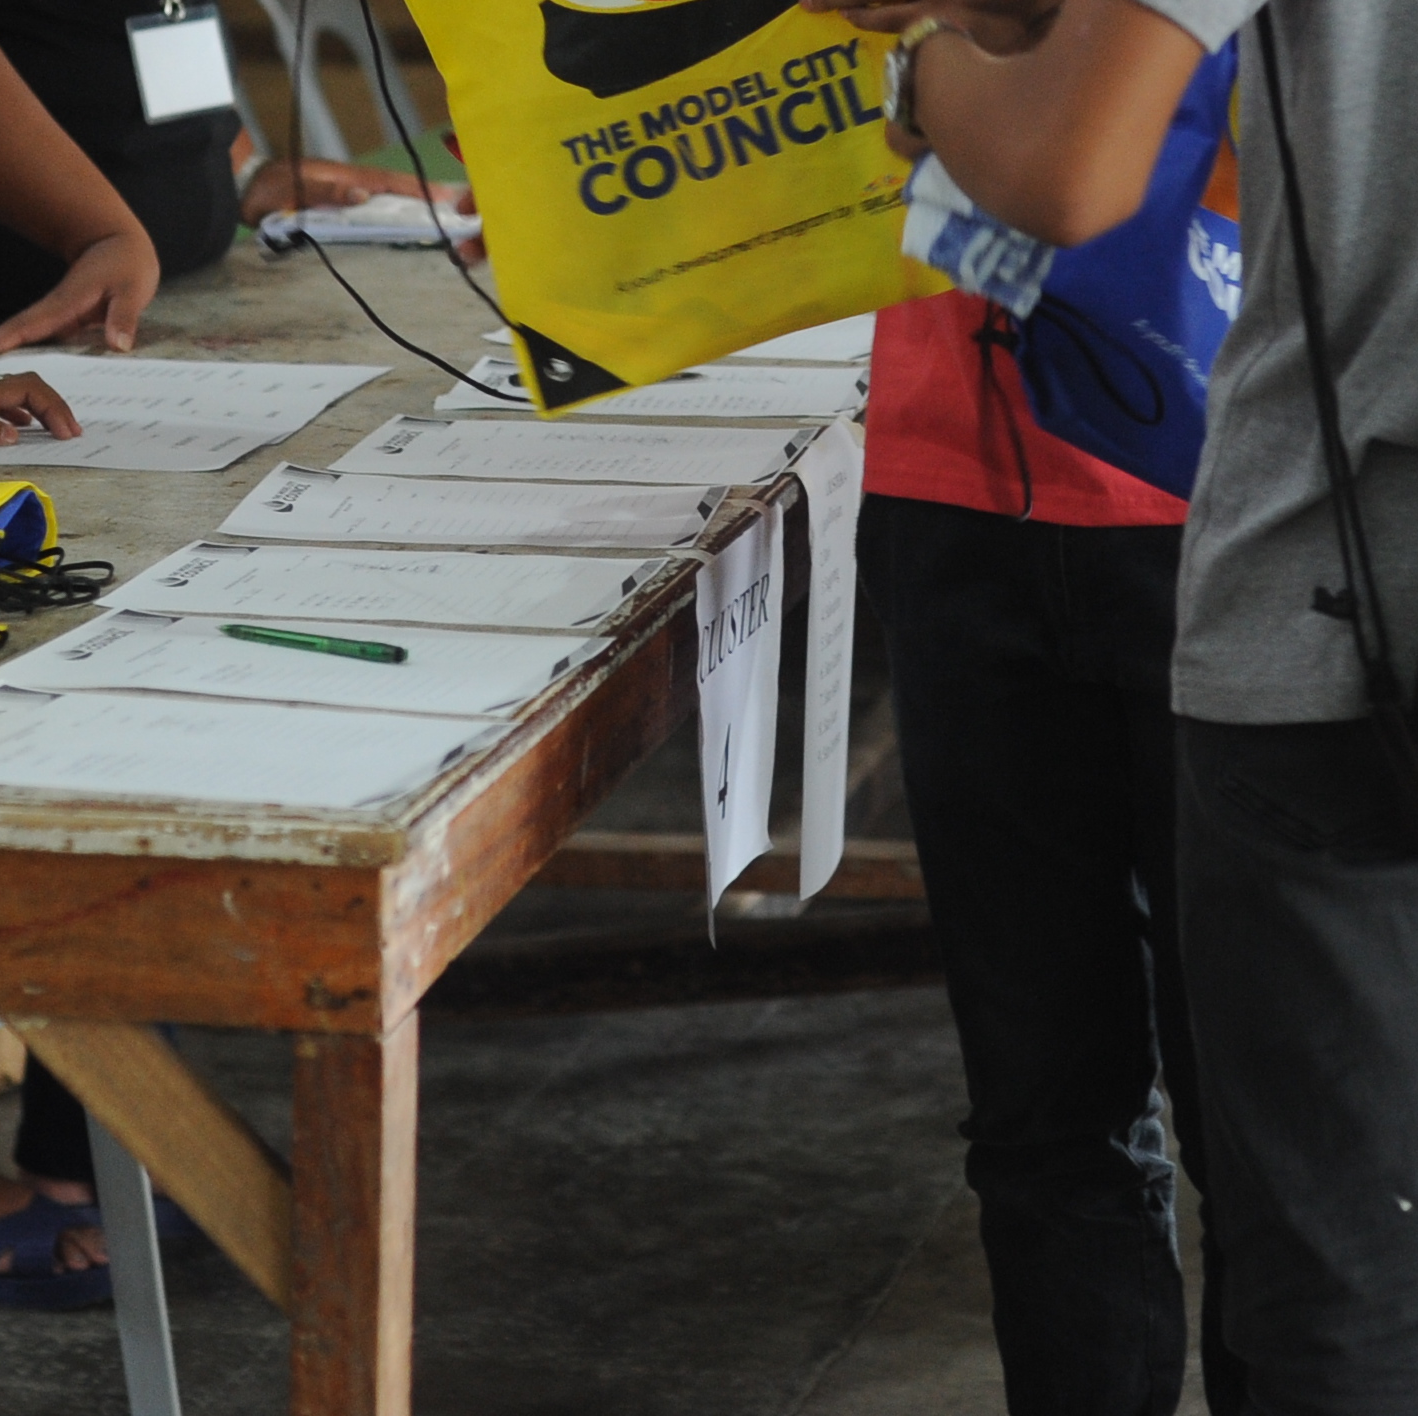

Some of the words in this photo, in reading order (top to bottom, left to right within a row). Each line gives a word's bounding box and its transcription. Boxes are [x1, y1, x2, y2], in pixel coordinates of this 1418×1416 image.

[559, 120, 636, 165] THE
[639, 71, 780, 140] MODEL
[780, 37, 860, 88] CITY
[578, 74, 885, 216] COUNCIL
[699, 573, 770, 684] CLUSTER
[717, 721, 732, 821] 4
